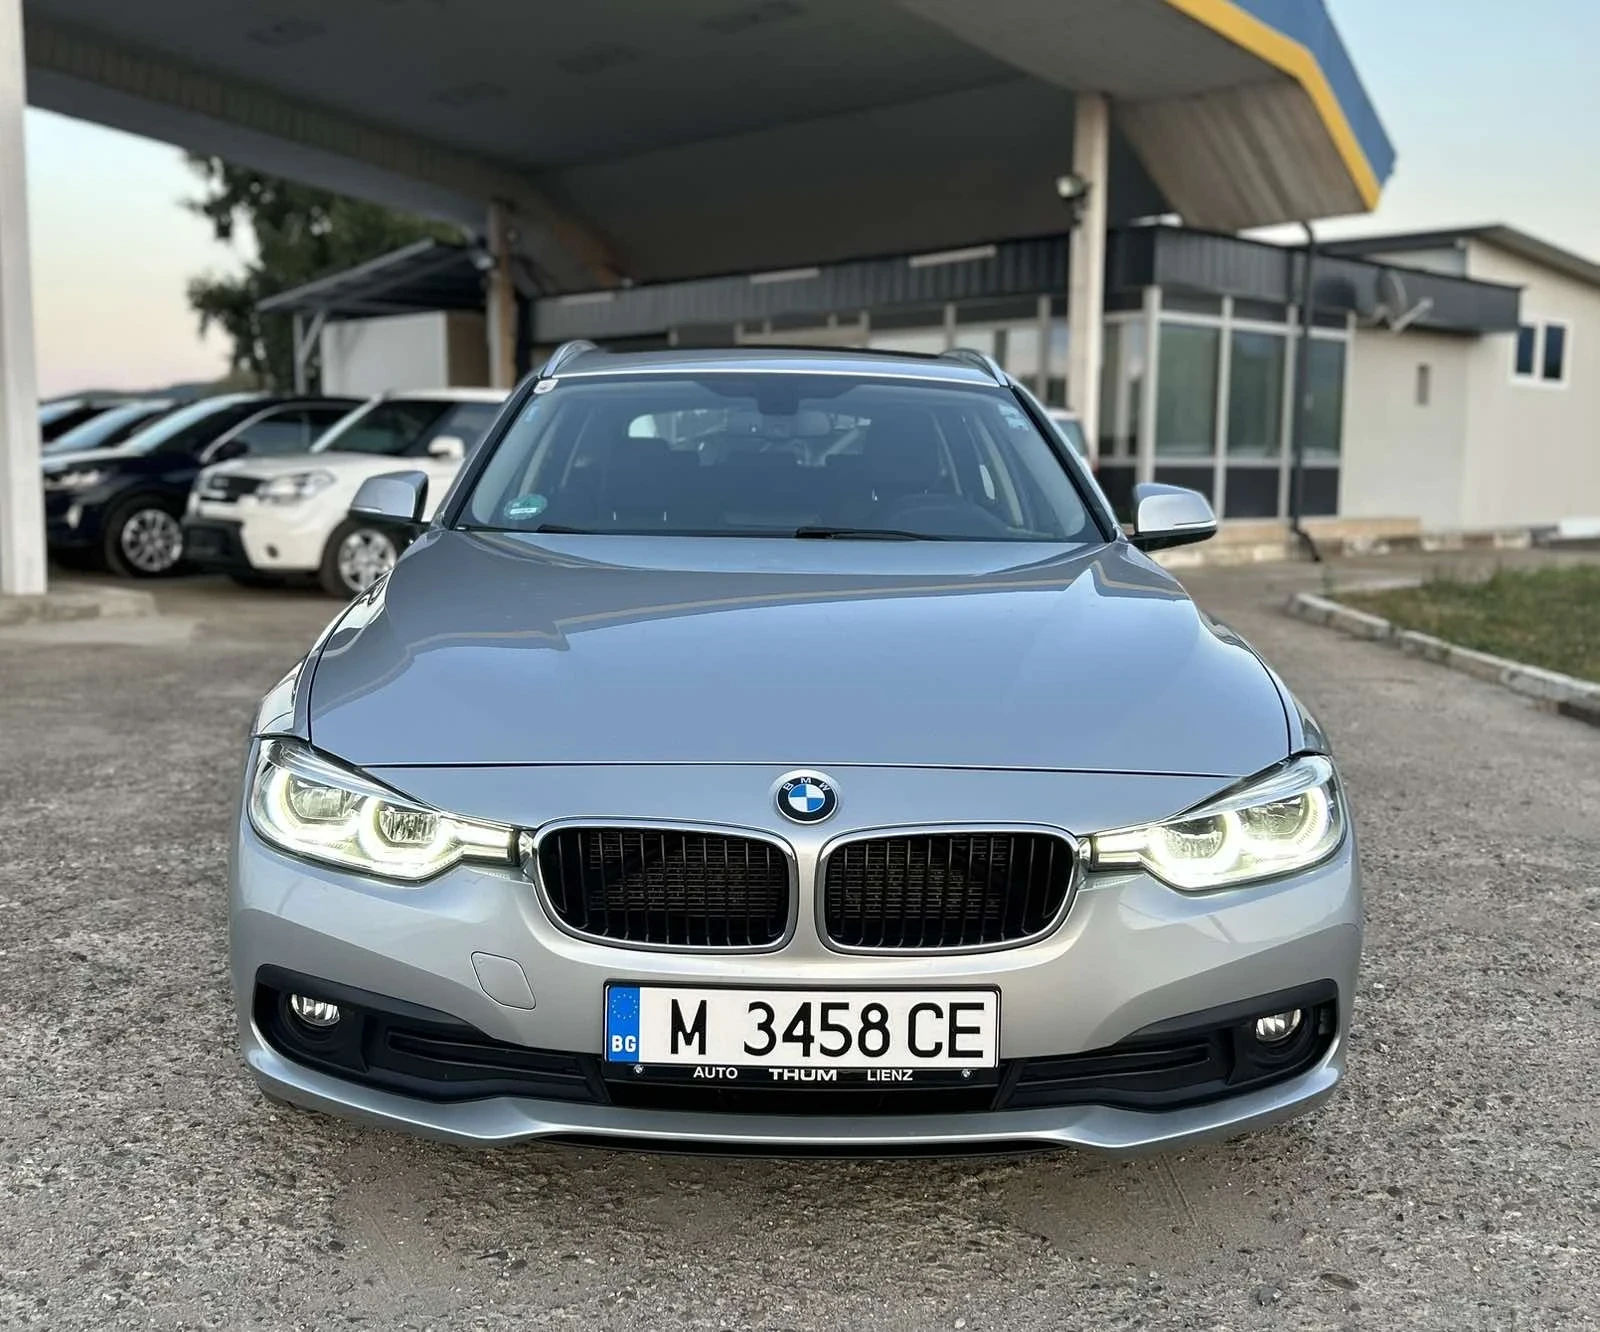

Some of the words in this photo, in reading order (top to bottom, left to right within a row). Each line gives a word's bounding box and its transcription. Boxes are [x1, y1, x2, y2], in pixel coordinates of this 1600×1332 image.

[783, 778, 830, 791] BMW
[670, 999, 707, 1055] M
[743, 1001, 890, 1058] 3458
[907, 1002, 985, 1059] CE
[611, 1035, 637, 1053] BG
[693, 1067, 738, 1079] AUTO
[768, 1068, 837, 1081] THUM
[866, 1069, 913, 1081] LIENZ
